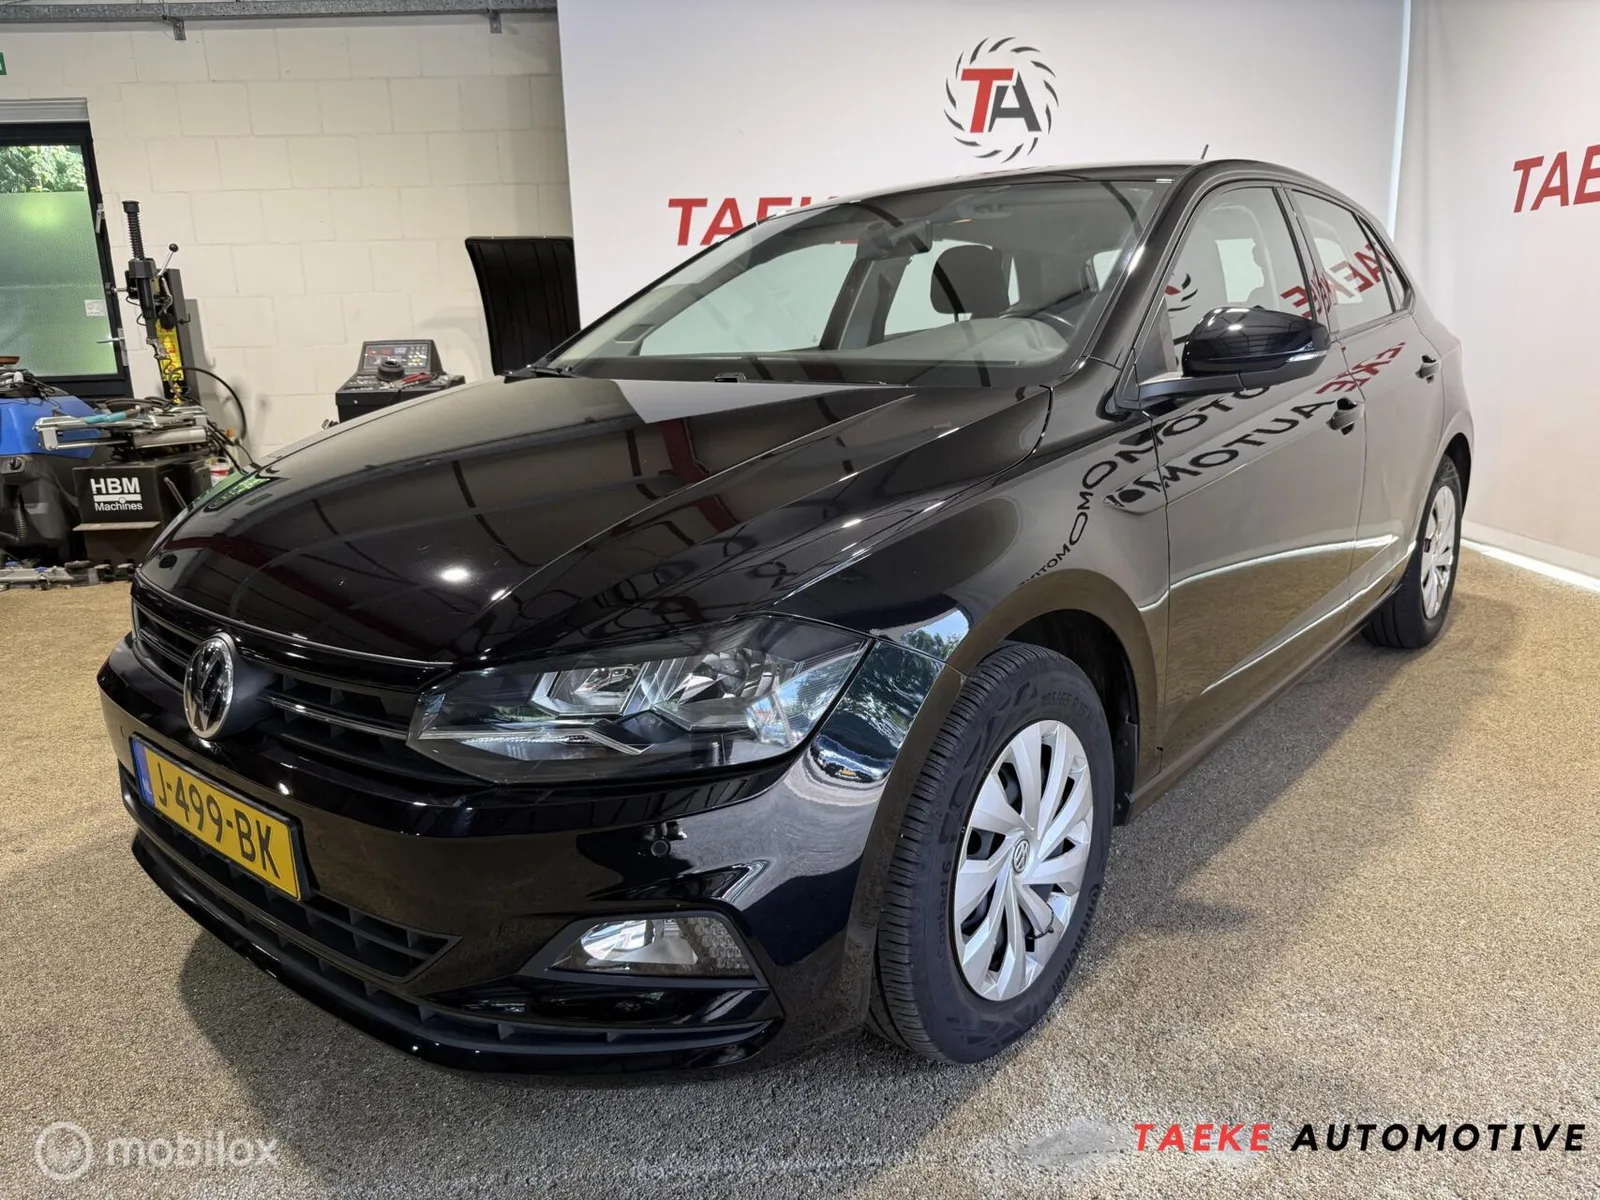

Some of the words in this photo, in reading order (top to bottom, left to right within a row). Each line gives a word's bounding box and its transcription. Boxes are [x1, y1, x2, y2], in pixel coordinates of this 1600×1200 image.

[961, 68, 1042, 133] TA
[1513, 144, 1600, 213] TAE
[90, 477, 141, 494] HBM
[94, 502, 143, 511] Machines
[157, 761, 280, 879] J-499-BK
